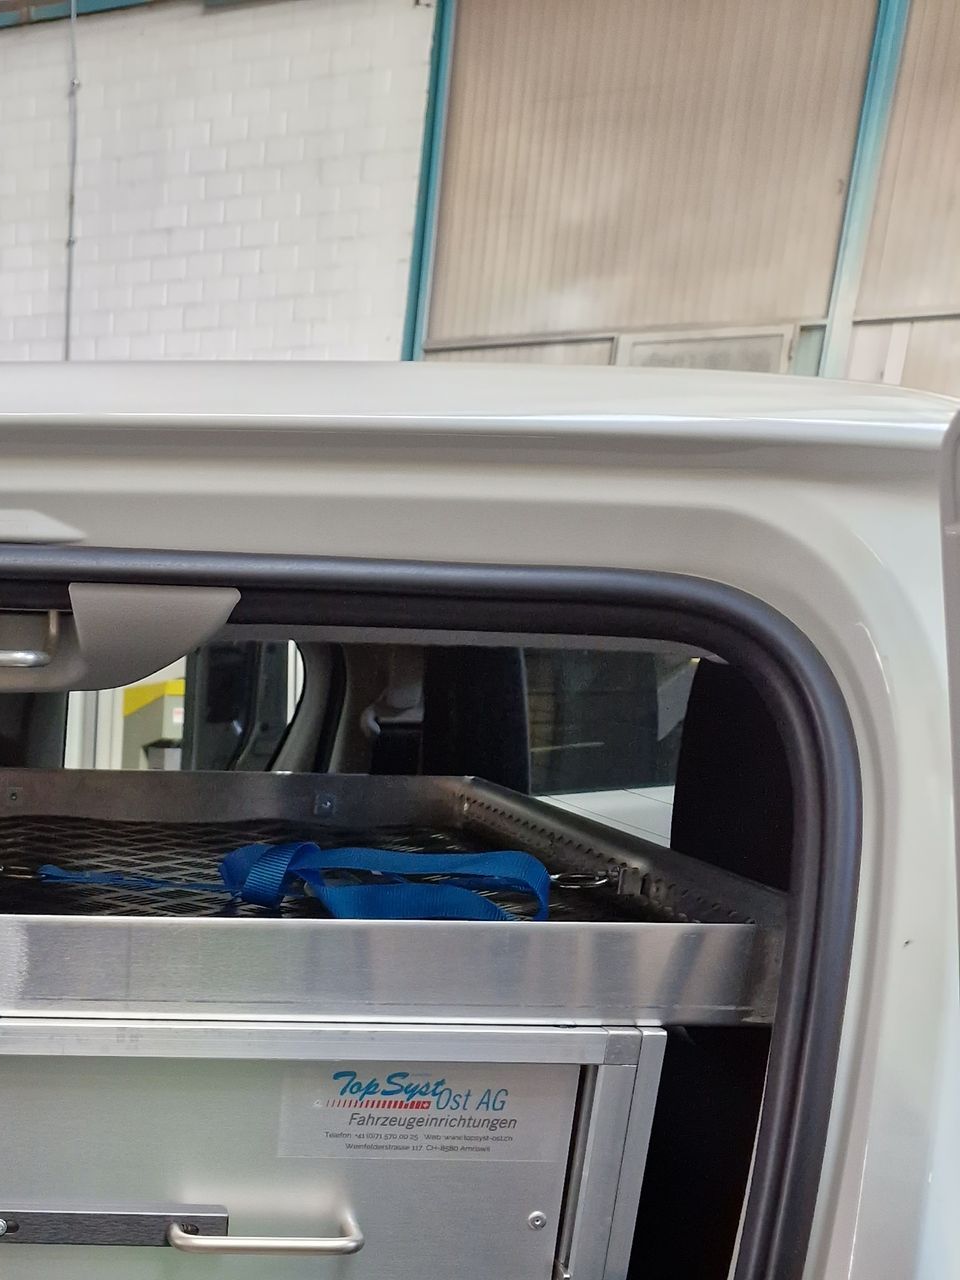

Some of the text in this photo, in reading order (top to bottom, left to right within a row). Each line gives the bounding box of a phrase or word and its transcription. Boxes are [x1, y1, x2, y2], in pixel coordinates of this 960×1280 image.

[437, 1088, 509, 1111] Ost AG
[348, 1113, 518, 1132] Fahrzeugeinrichtungen
